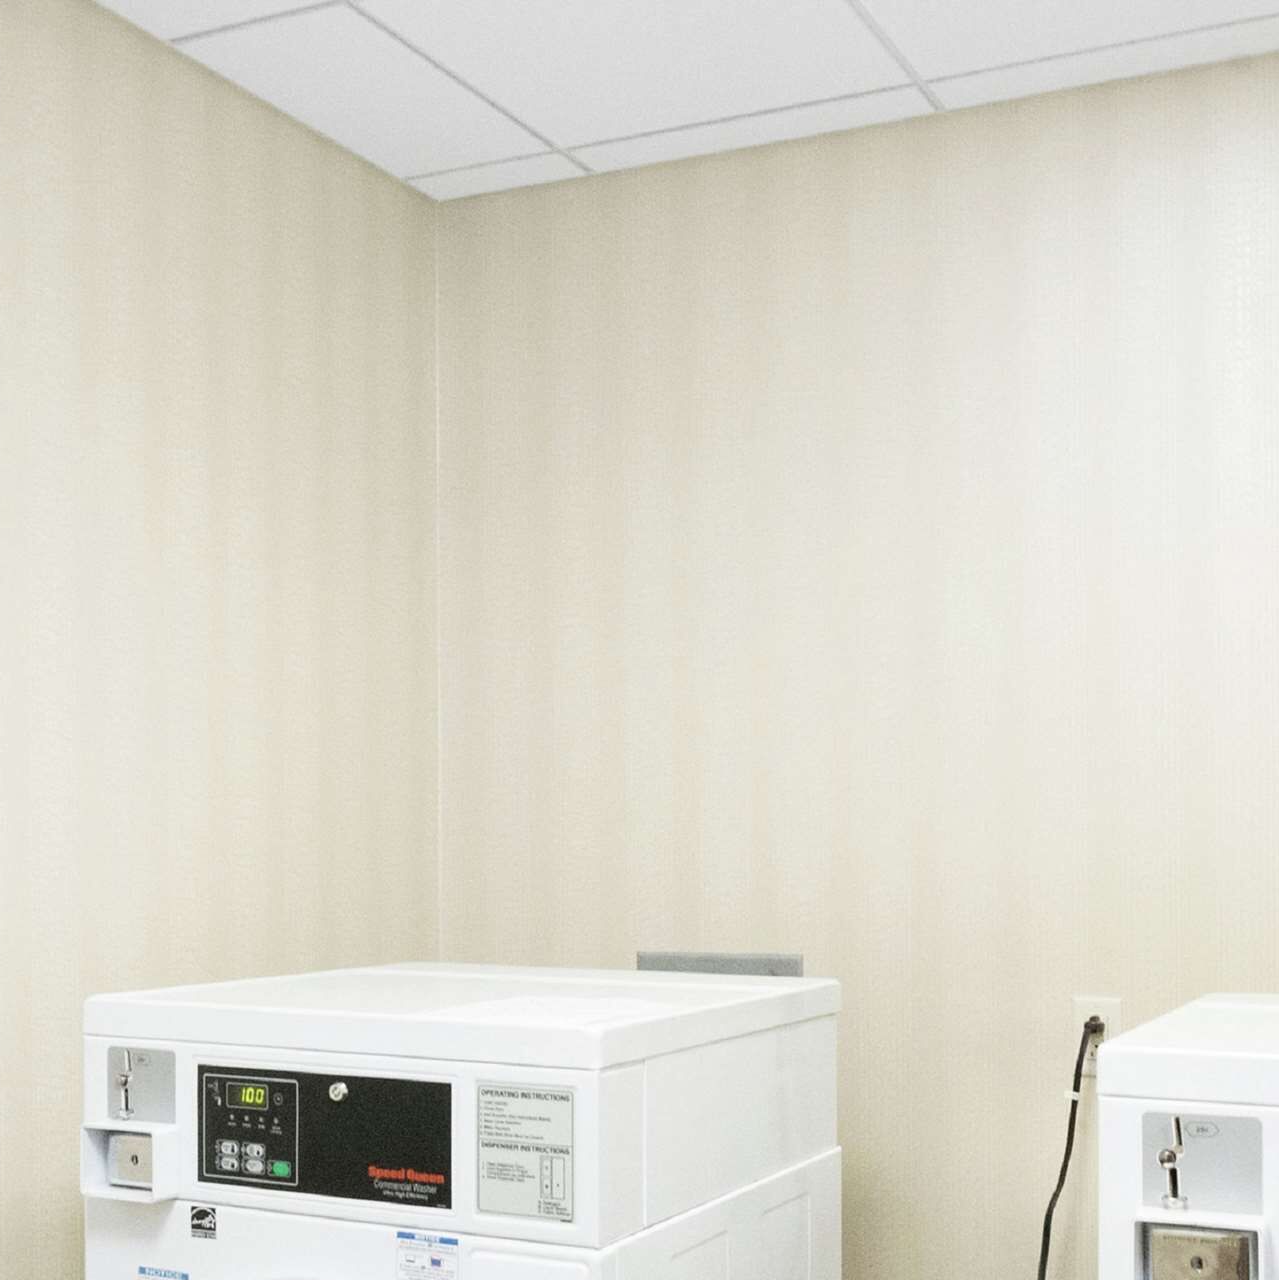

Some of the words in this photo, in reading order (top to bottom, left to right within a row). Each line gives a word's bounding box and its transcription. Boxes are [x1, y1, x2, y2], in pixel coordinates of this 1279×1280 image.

[240, 1087, 265, 1104] 100
[481, 1089, 520, 1099] OPERATING
[520, 1092, 570, 1102] INSTRUCTIONS
[520, 1144, 570, 1155] INSTRUCTIONS
[368, 1166, 405, 1180] Speed
[406, 1168, 445, 1184] Queen
[373, 1180, 412, 1192] Commercial
[413, 1184, 437, 1194] Washer
